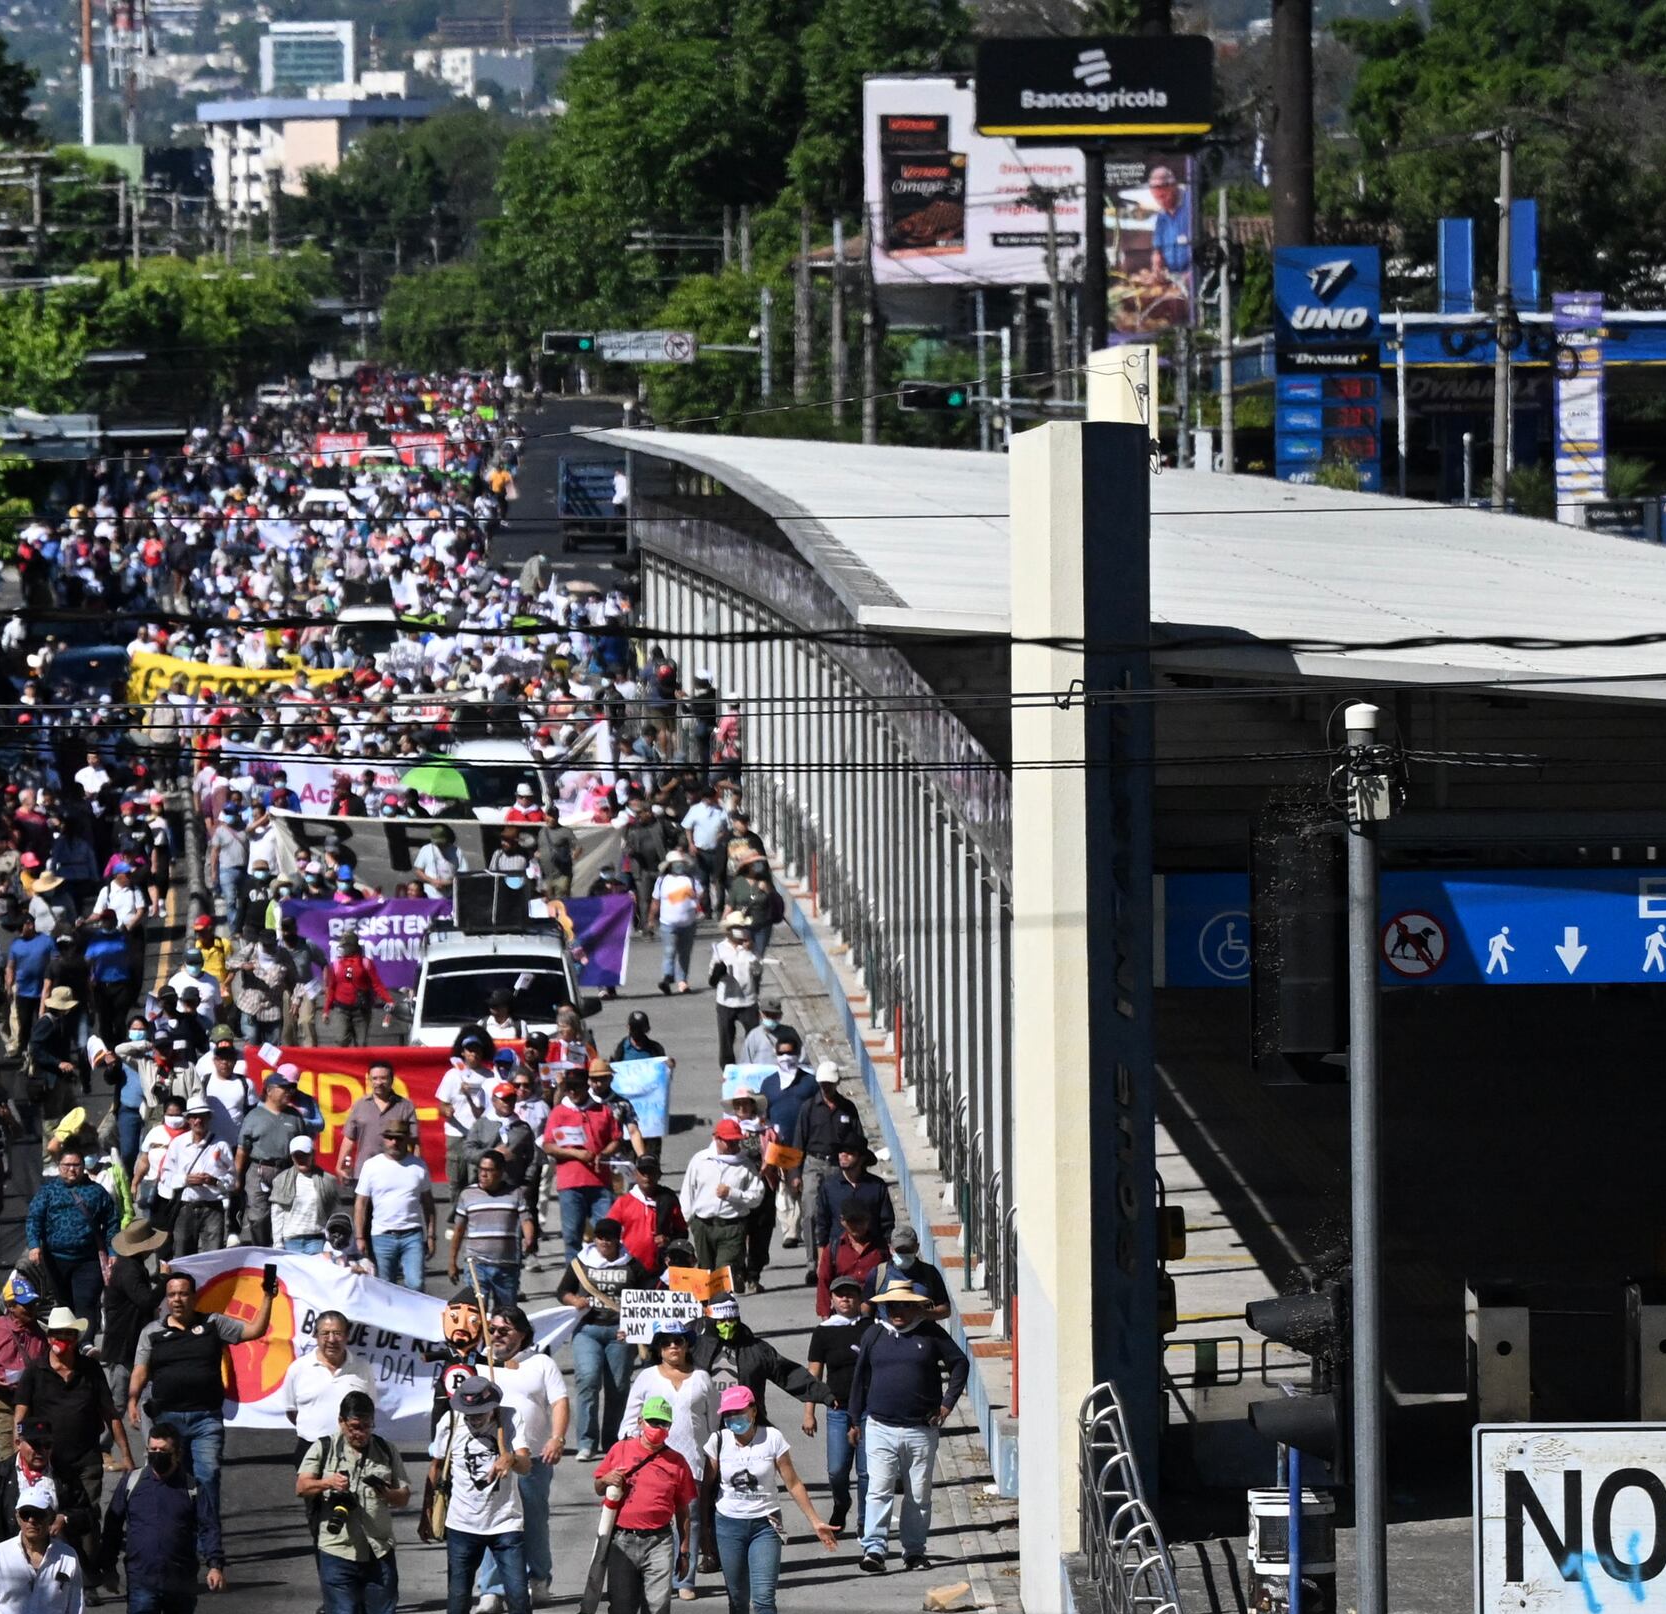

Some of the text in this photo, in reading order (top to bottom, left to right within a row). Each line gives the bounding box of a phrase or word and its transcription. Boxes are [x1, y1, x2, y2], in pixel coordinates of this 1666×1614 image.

[1290, 305, 1369, 331] UNO
[624, 1290, 666, 1304] CUANDO
[671, 1291, 700, 1304] OCUL
[626, 1323, 646, 1336] HAY
